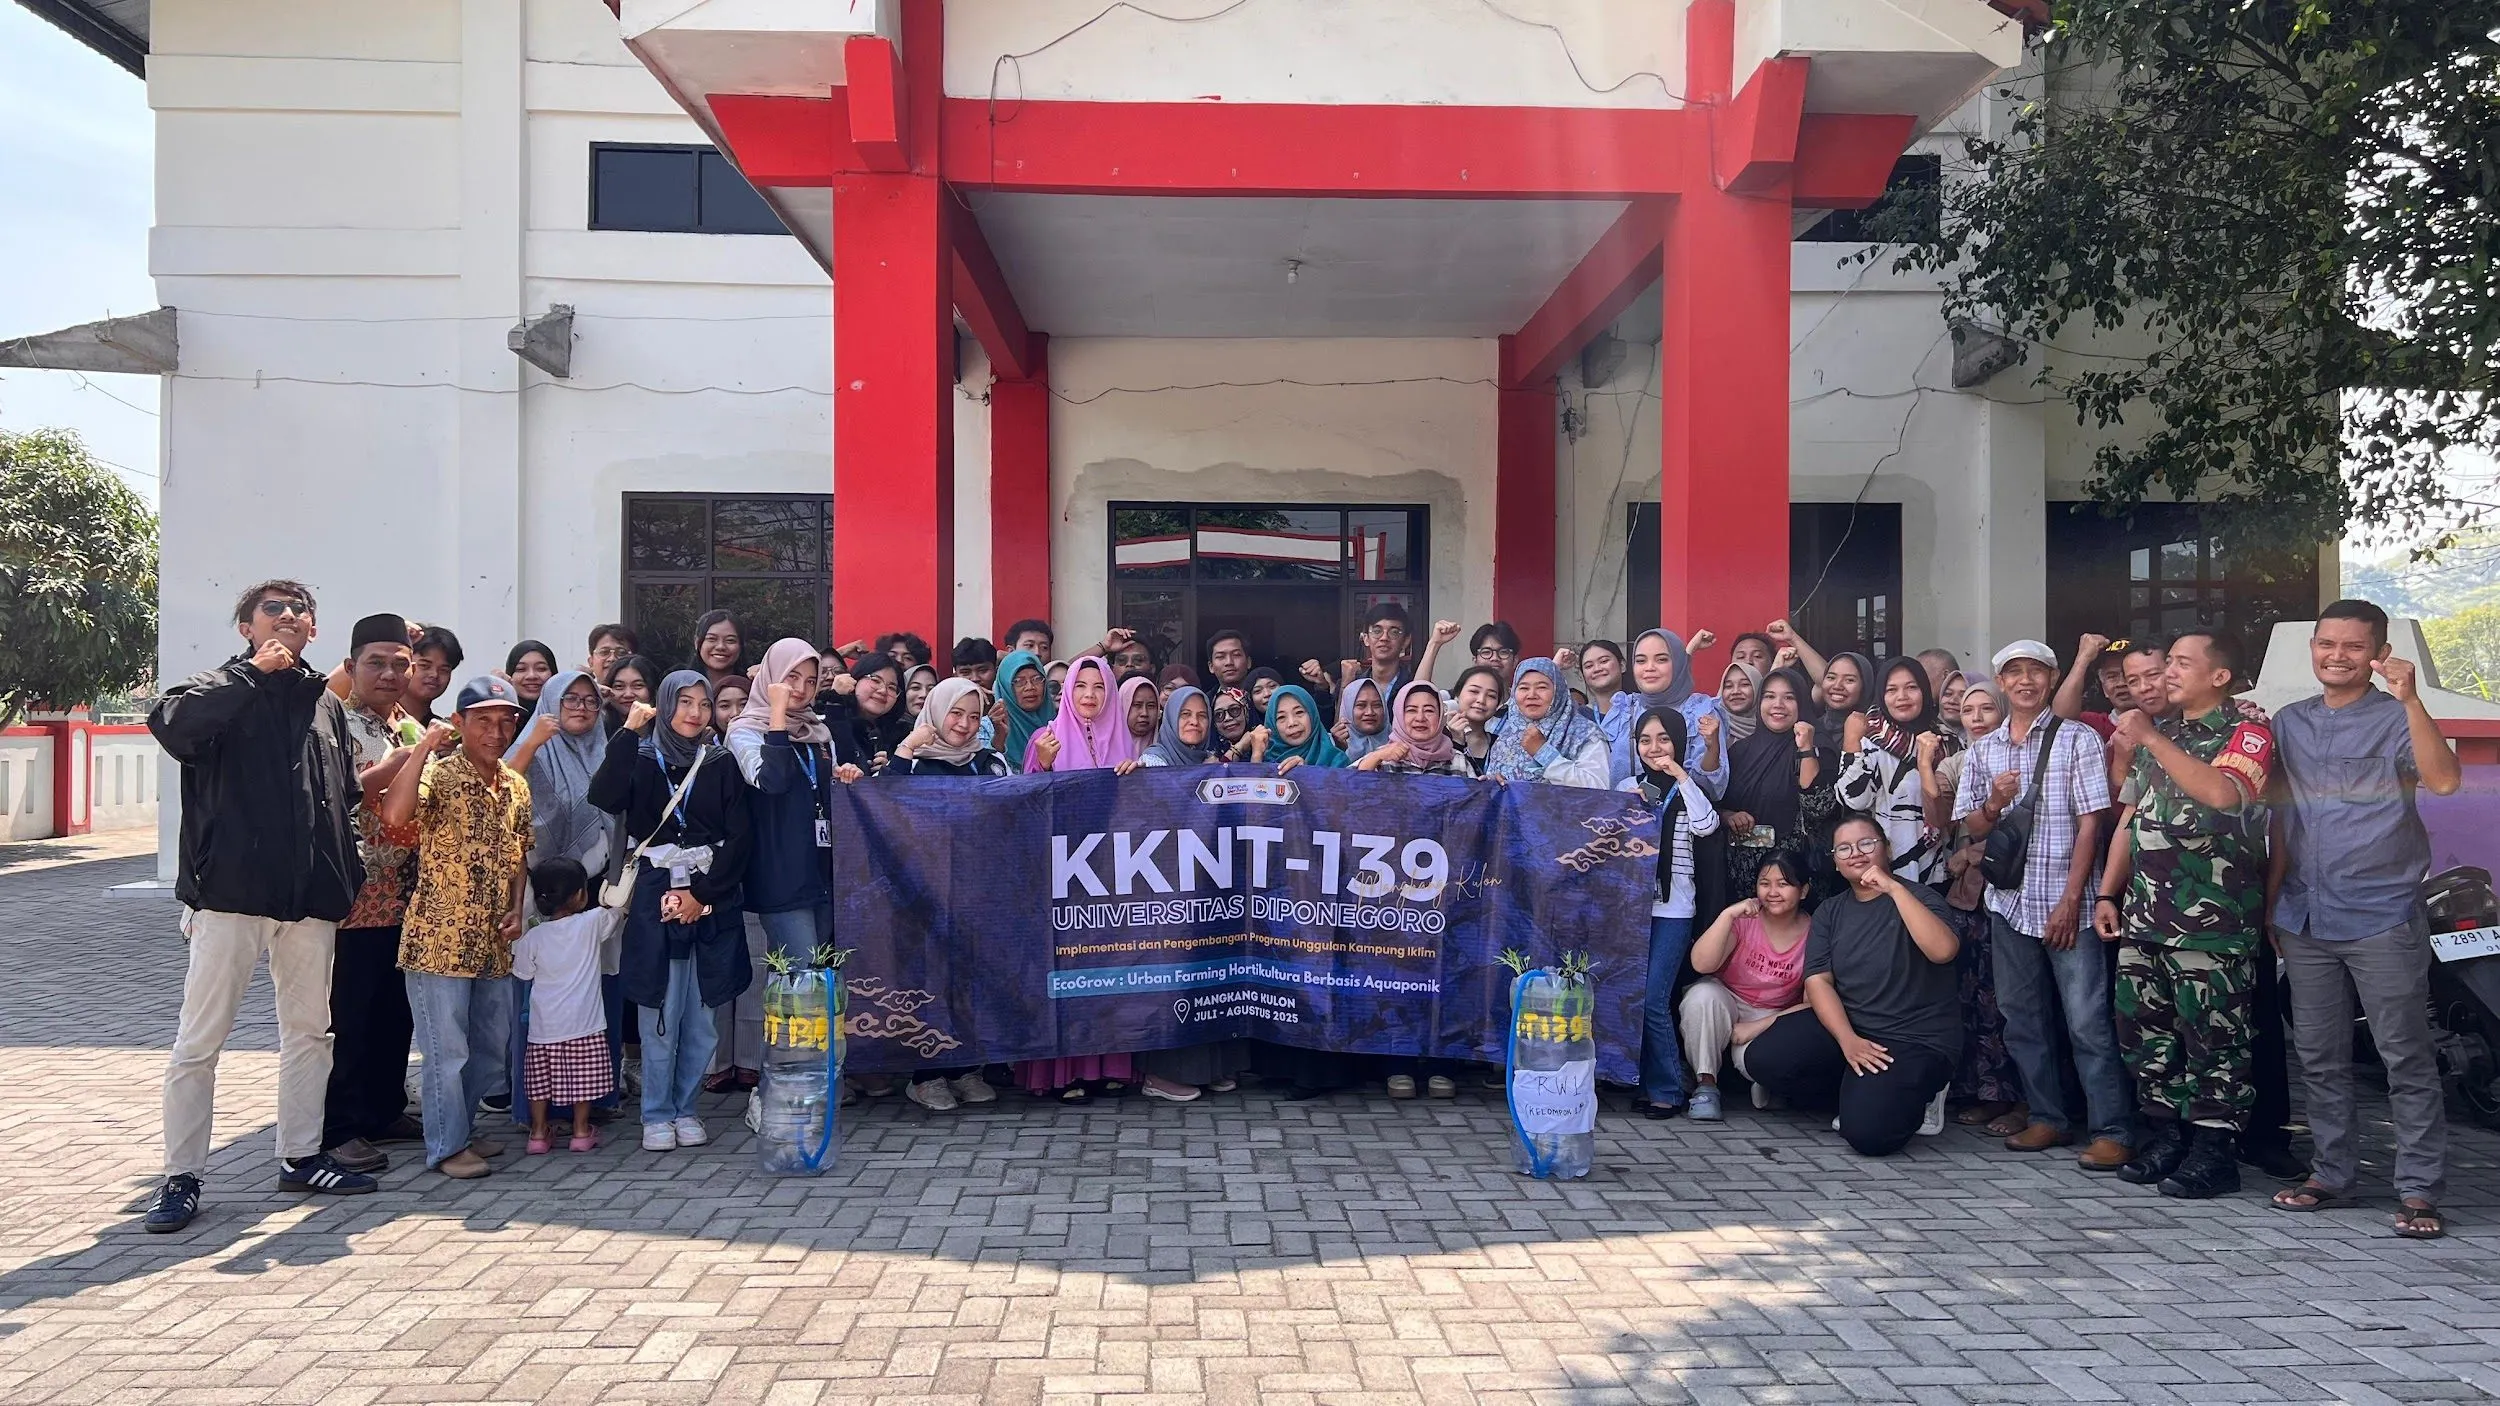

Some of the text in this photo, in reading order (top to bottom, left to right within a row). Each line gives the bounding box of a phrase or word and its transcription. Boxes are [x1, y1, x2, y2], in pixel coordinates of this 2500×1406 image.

[1051, 825, 1449, 902] KKNT-139
[1455, 861, 1503, 901] Kulon
[1052, 894, 1446, 934] UNIVERSITAS DIPONEGORO
[1056, 933, 1436, 959] Implementasi dan Pengembangan Program Unggulan Kampung Iklim
[2431, 937, 2443, 948] H
[2450, 931, 2485, 946] 2891
[1053, 975, 1116, 991] EcoGrow
[1127, 972, 1172, 986] Urban
[1174, 965, 1227, 983] Farming
[1229, 962, 1301, 983] Hortikultura
[1303, 970, 1361, 988] Berbasis
[1363, 975, 1441, 994] Aquaponik
[1193, 989, 1296, 1009] MANGKANG KULON
[1193, 1011, 1218, 1023] JULI
[1226, 1004, 1271, 1020] AGUSTUS
[1272, 1009, 1299, 1024] 2025
